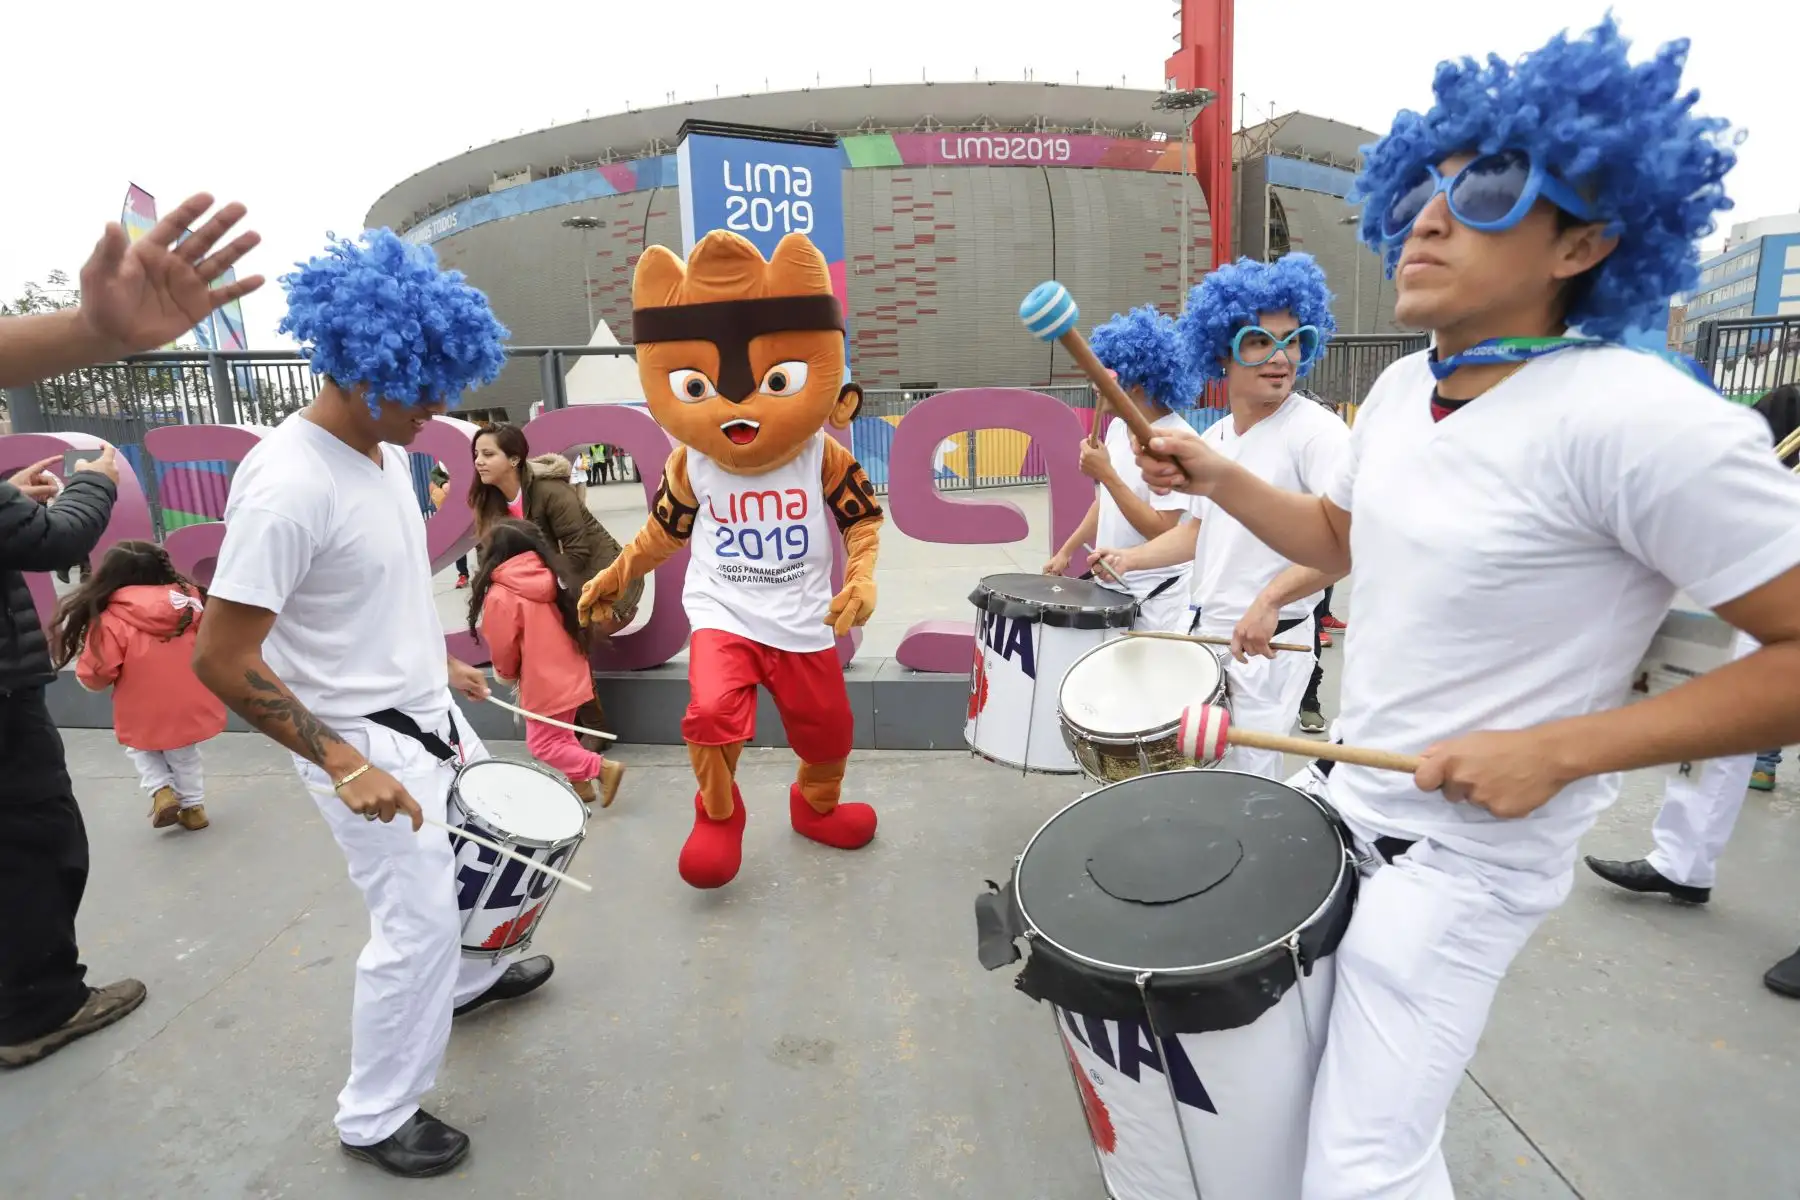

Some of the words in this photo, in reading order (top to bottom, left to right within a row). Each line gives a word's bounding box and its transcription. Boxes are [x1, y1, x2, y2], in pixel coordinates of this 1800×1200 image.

[432, 212, 458, 235] TODOS
[725, 195, 814, 235] 2019
[715, 524, 809, 561] 2019
[716, 563, 743, 573] JUEGOS
[743, 561, 805, 576] PANAMERICANOS
